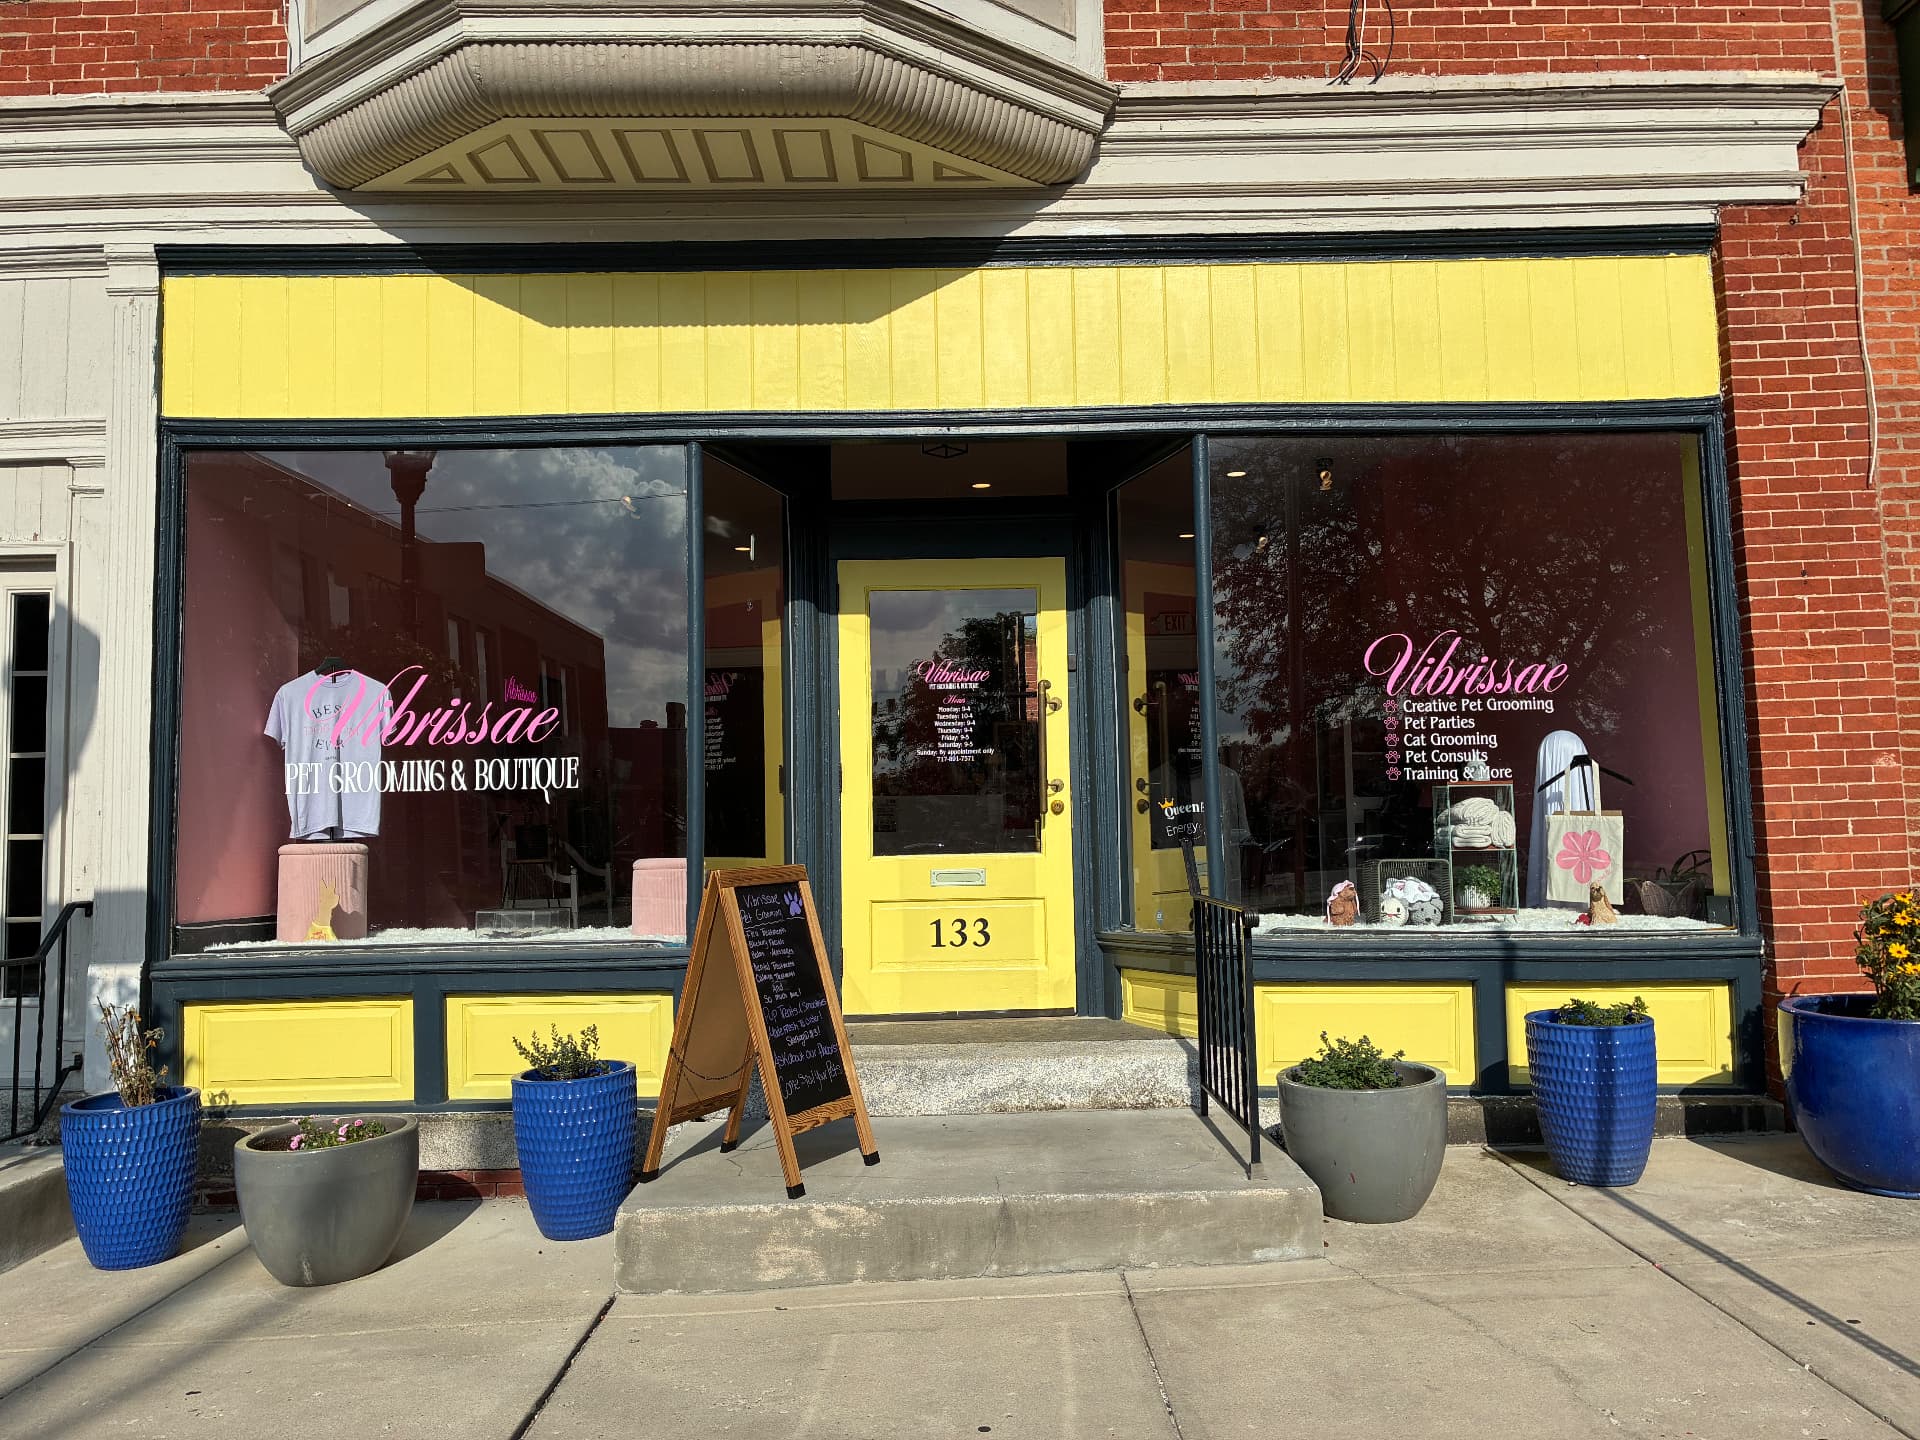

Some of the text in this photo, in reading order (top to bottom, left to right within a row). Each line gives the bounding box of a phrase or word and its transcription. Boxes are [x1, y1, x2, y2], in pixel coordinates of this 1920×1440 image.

[1165, 615, 1185, 631] EXIT
[917, 659, 991, 683] Vibrissae
[1363, 629, 1569, 697] Vibrissae
[304, 665, 560, 748] Vibrissae
[1403, 696, 1554, 713] Creative Pet Grooming
[1404, 716, 1475, 730] Pet Parties
[1403, 731, 1498, 748] Cat Grooming
[983, 747, 995, 755] only
[1405, 749, 1488, 763] Pet Consults
[285, 756, 580, 805] PET GROOMING & BOUTIQUE
[1403, 766, 1513, 783] Training & More
[929, 917, 991, 948] 133
